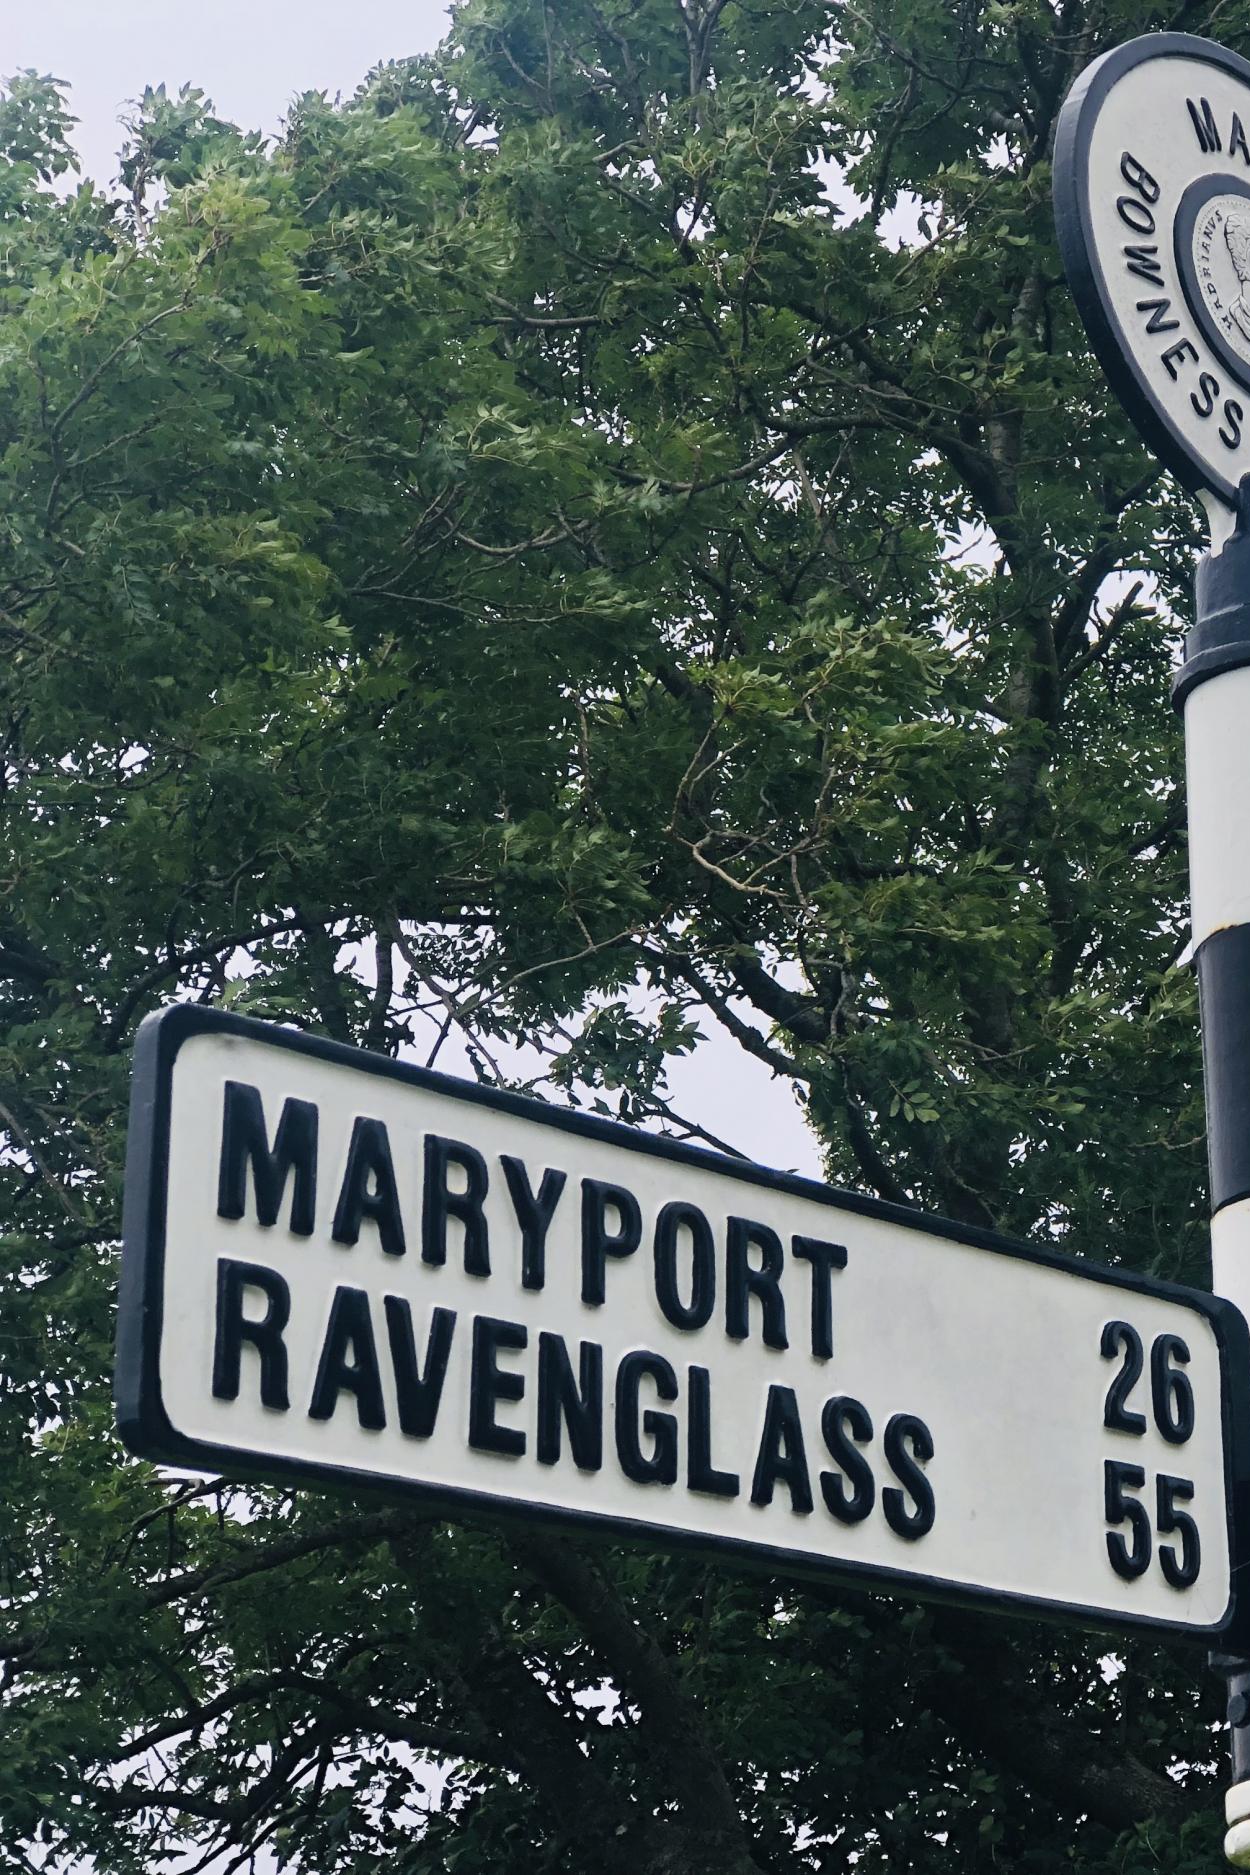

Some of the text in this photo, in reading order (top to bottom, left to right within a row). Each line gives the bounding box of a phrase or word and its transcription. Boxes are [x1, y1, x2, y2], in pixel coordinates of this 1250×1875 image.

[1117, 152, 1243, 449] BOWNESS
[212, 1258, 1200, 1588] RAVENGLASS 55
[217, 1080, 1195, 1444] MARYPORT 26
